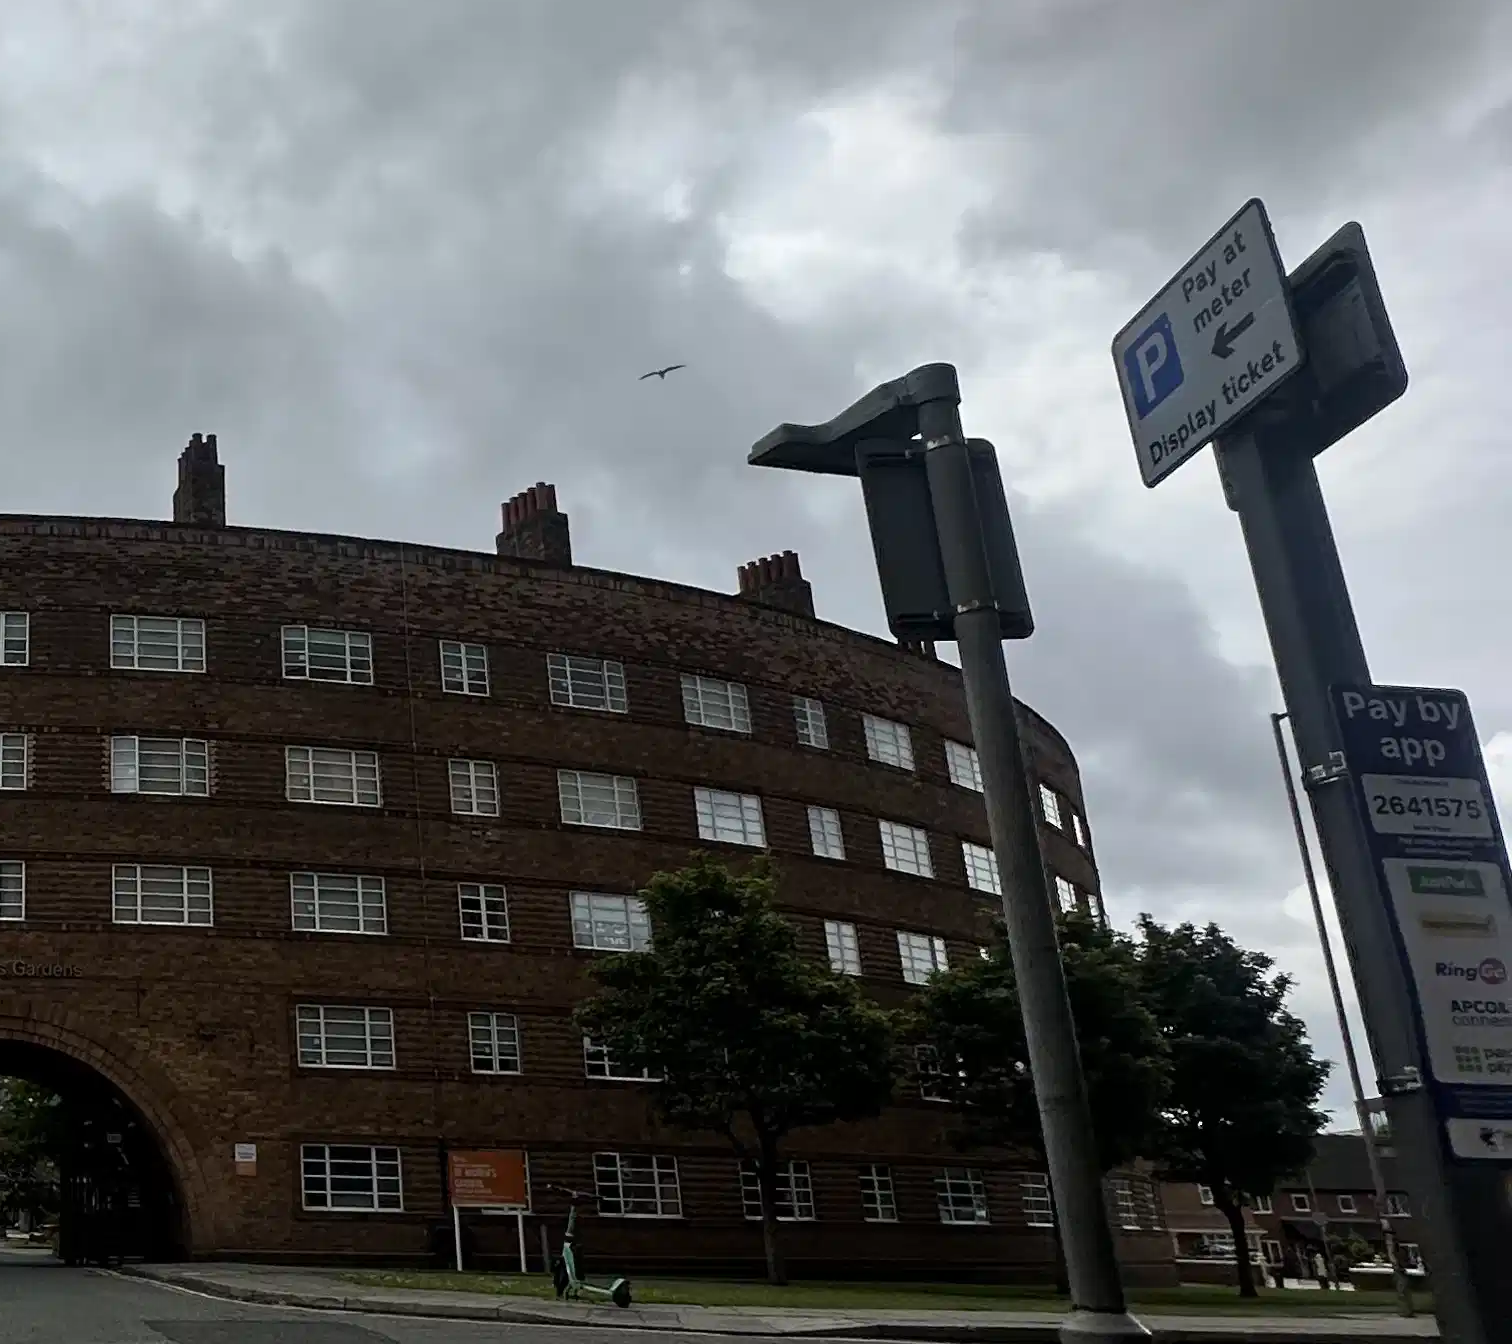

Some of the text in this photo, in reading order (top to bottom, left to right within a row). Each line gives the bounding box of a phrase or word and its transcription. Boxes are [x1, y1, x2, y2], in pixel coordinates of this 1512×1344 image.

[1182, 230, 1247, 303] Pay at
[1192, 267, 1251, 334] meter
[1136, 331, 1168, 404] P
[1149, 339, 1286, 465] Display ticket
[1341, 691, 1461, 730] Pay by
[1379, 736, 1446, 768] app
[1372, 795, 1482, 820] 2641575
[12, 959, 83, 977] Gardens
